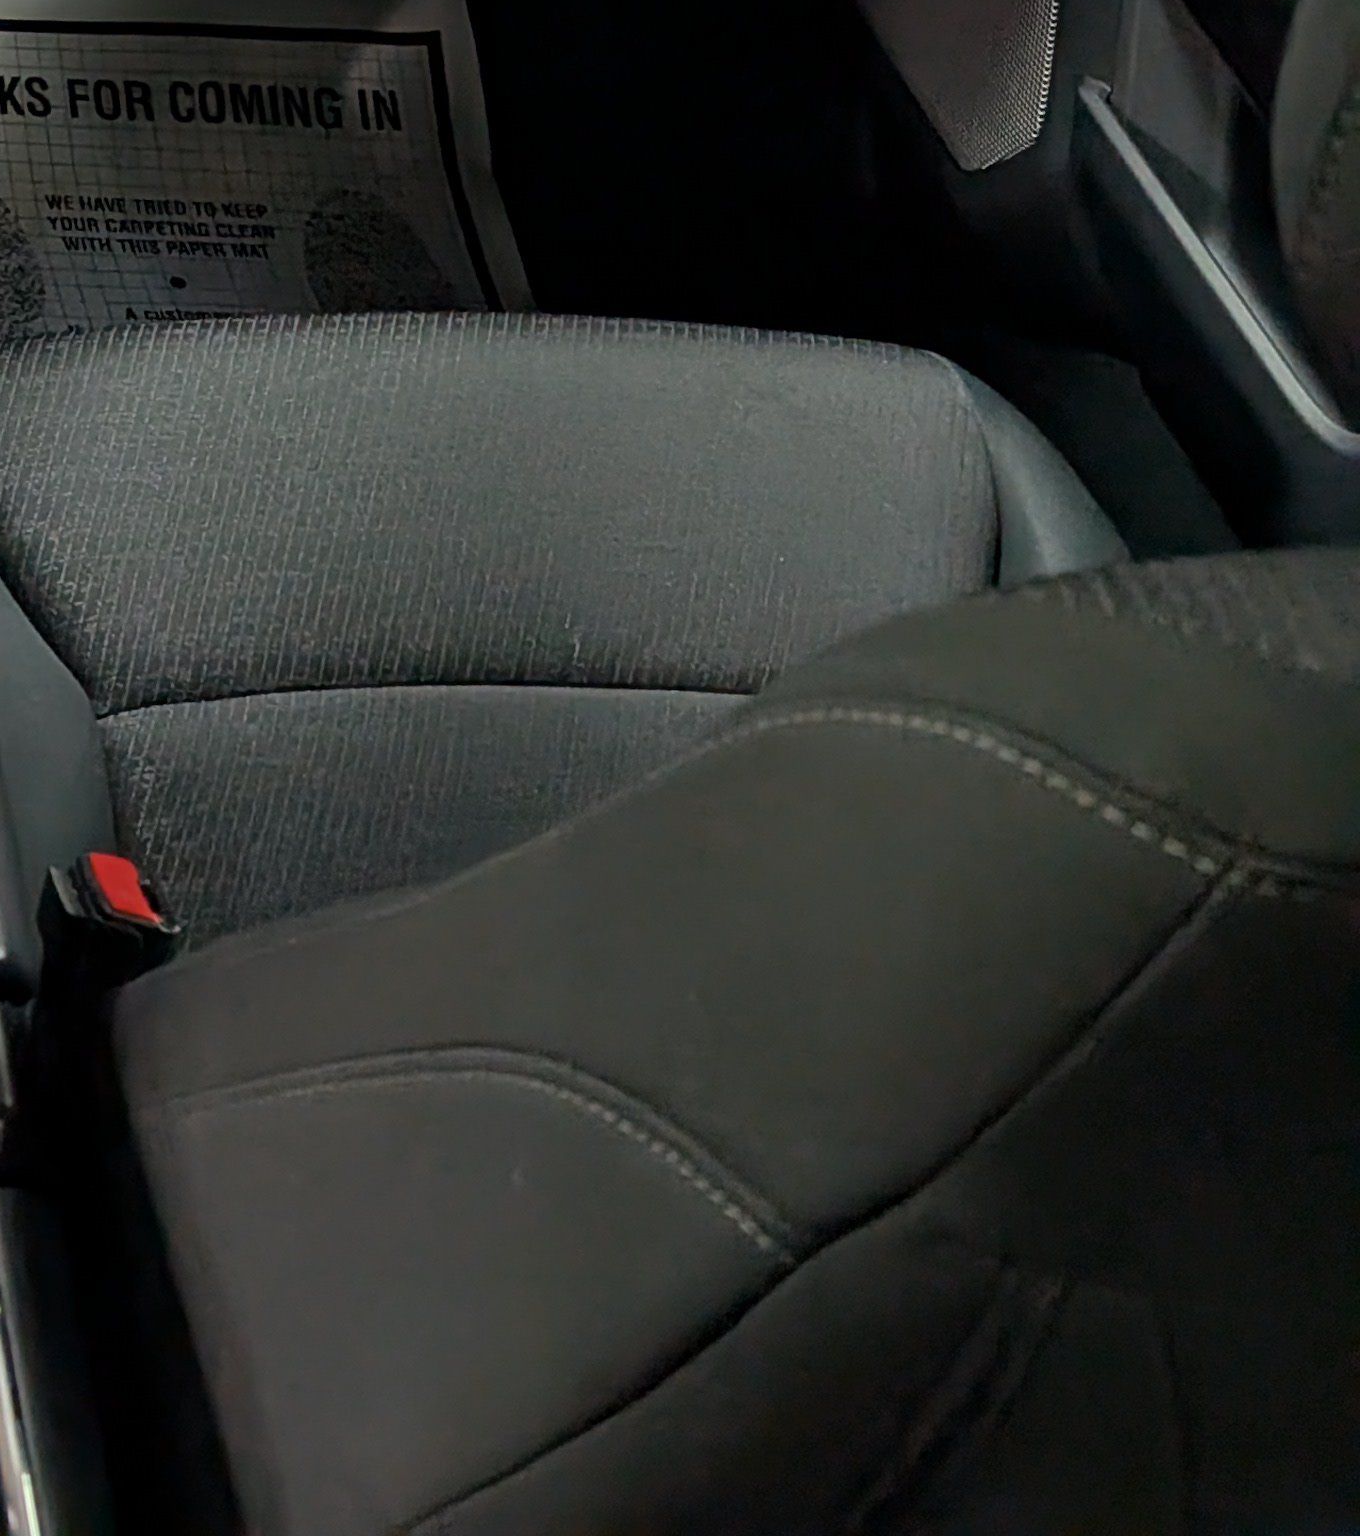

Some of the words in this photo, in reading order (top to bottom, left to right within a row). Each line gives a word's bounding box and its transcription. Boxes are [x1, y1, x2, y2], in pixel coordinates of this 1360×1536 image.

[67, 78, 154, 121] FOR
[169, 81, 343, 129] COMING
[358, 88, 402, 131] IN
[45, 194, 74, 210] WE
[79, 195, 126, 212] HAVE
[133, 198, 187, 215] TRIED
[192, 201, 216, 217] TO
[221, 202, 268, 219] KEEP
[46, 216, 99, 233] YOUR
[105, 218, 210, 237] CARPETING
[215, 222, 275, 239] CLEAN
[62, 236, 111, 252] WITH
[117, 238, 160, 255] THIS
[166, 240, 226, 257] PAPER
[231, 243, 269, 259] MAT
[125, 308, 137, 320] A
